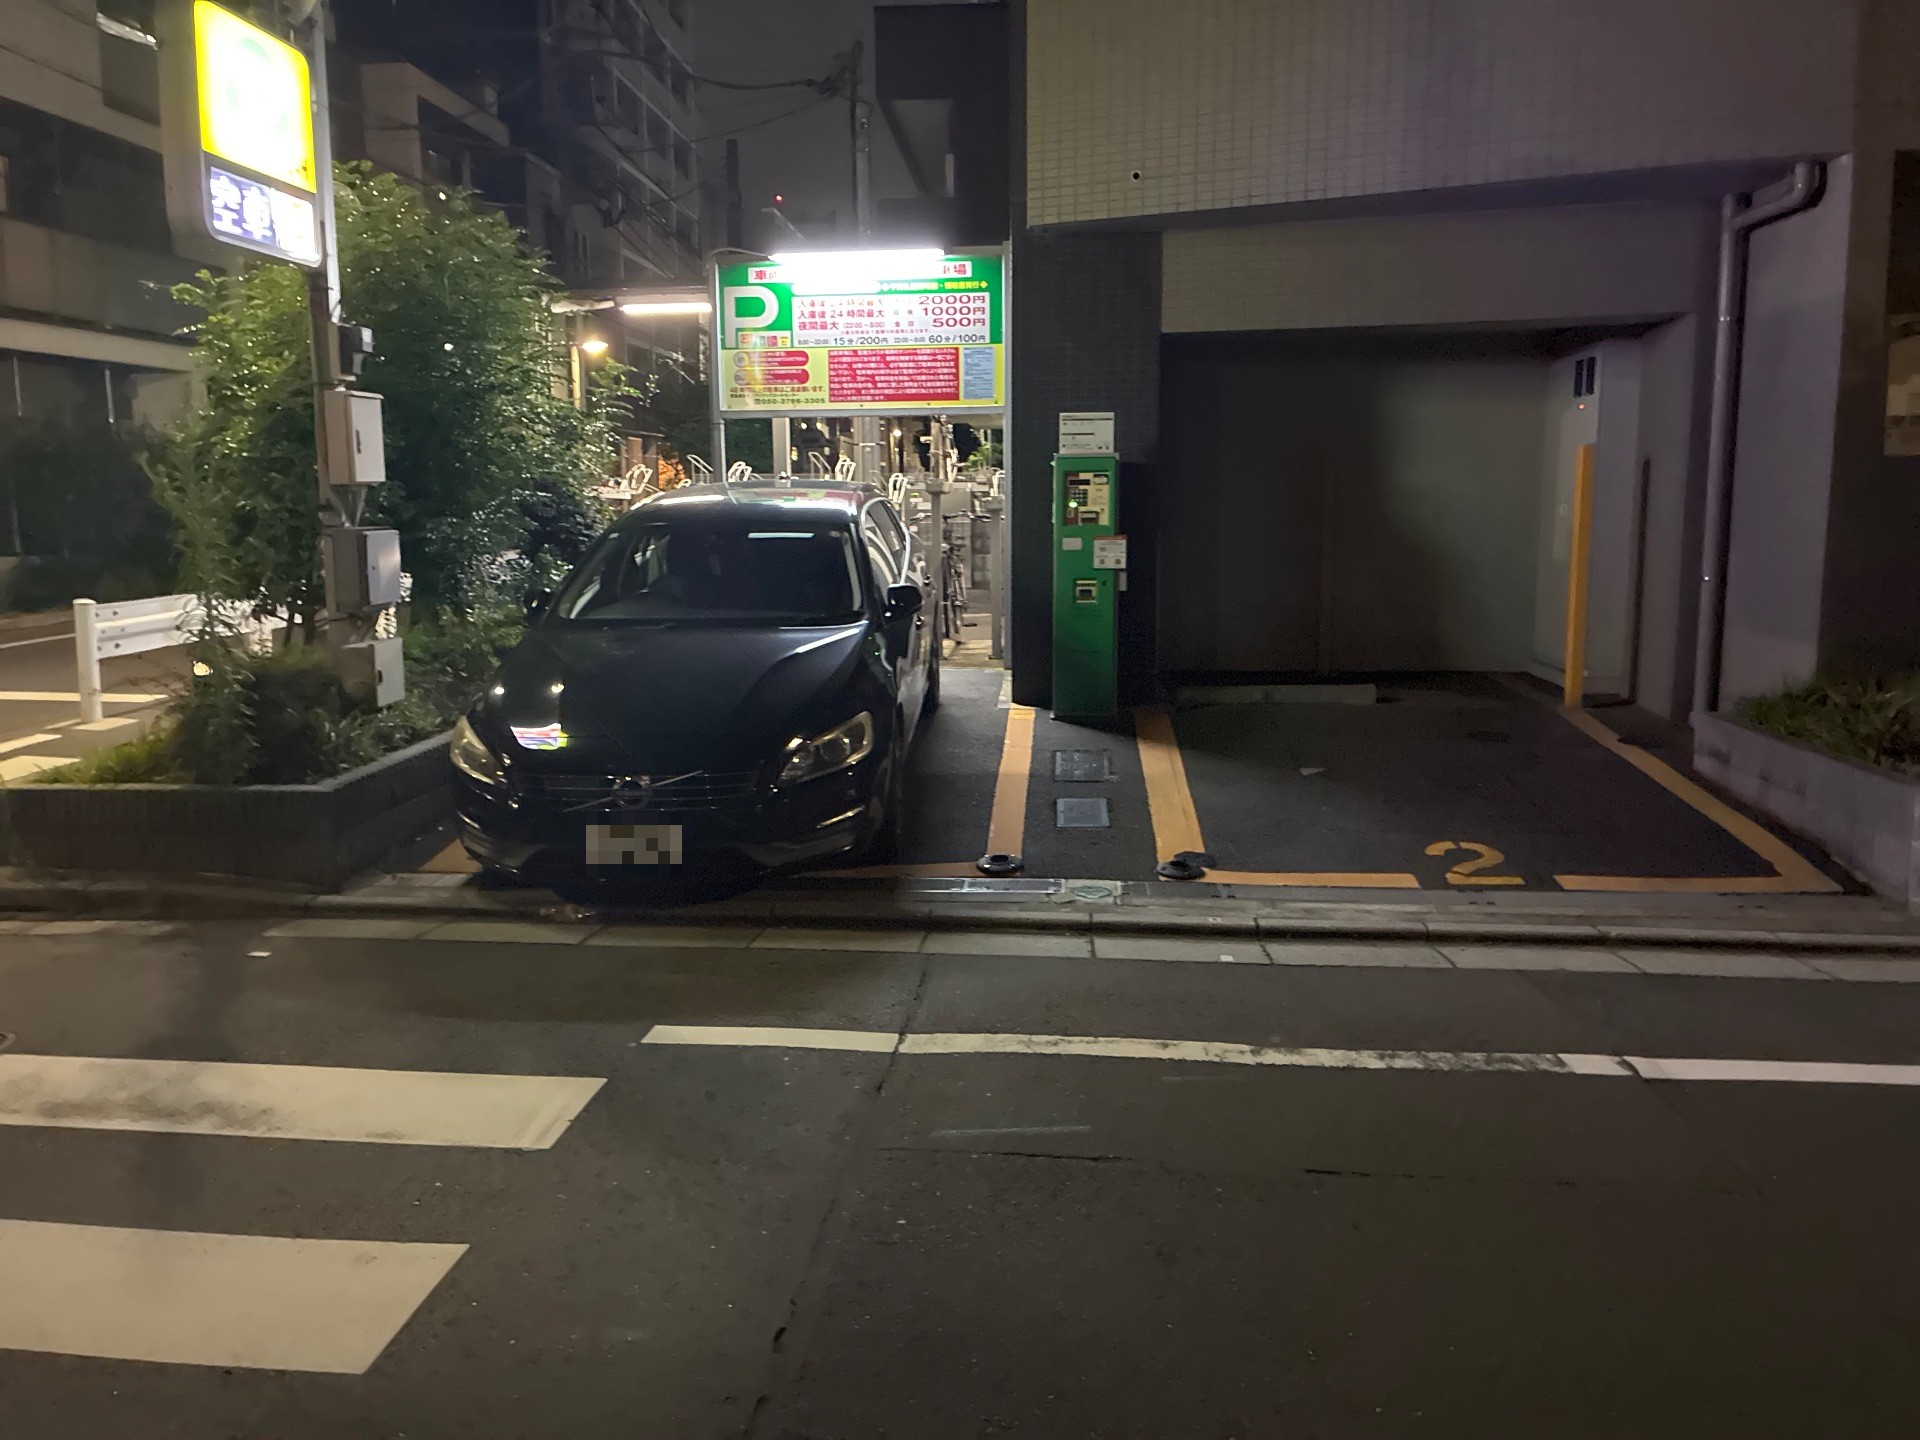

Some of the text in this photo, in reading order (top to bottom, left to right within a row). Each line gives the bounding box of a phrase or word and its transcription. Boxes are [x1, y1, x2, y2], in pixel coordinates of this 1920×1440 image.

[919, 294, 986, 305] 2000円
[723, 285, 780, 348] P
[922, 306, 986, 316] 1000円
[931, 317, 986, 328] 500円
[1424, 840, 1526, 886] 2
